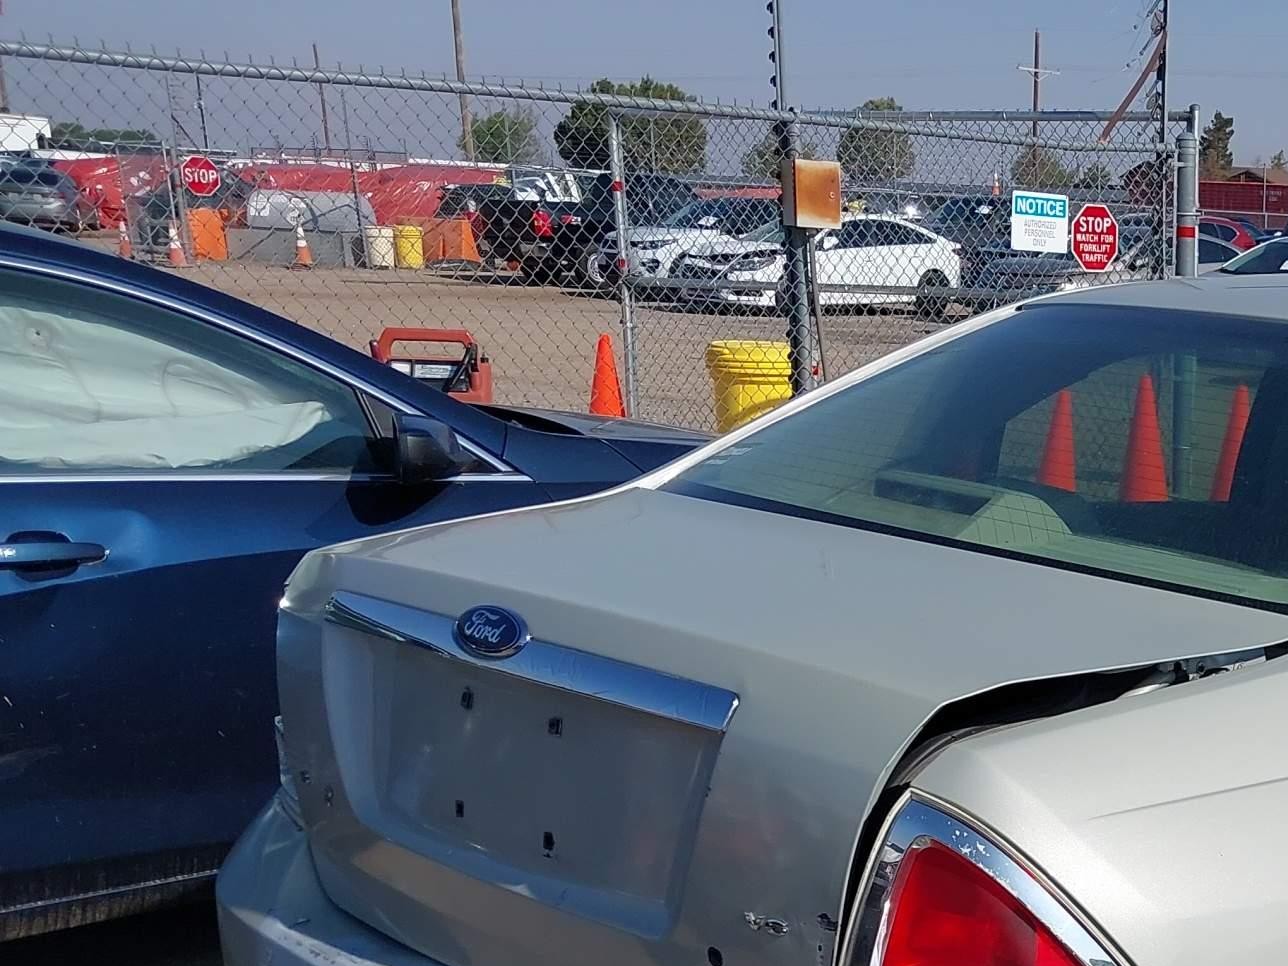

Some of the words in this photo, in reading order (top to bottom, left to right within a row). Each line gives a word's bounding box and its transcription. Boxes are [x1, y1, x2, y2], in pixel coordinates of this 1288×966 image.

[184, 168, 217, 183] STOP
[1016, 197, 1065, 216] NOTICE
[1024, 219, 1057, 230] AUTHORIZED
[1079, 216, 1112, 232] STOP
[1024, 228, 1056, 238] PERSONNEL
[1075, 233, 1099, 242] WATCH
[1100, 234, 1114, 243] FOR
[1032, 238, 1047, 247] ONLY
[1079, 243, 1111, 253] FORKLIFT
[1081, 253, 1108, 262] TRAFFIC
[464, 610, 506, 643] Ford
